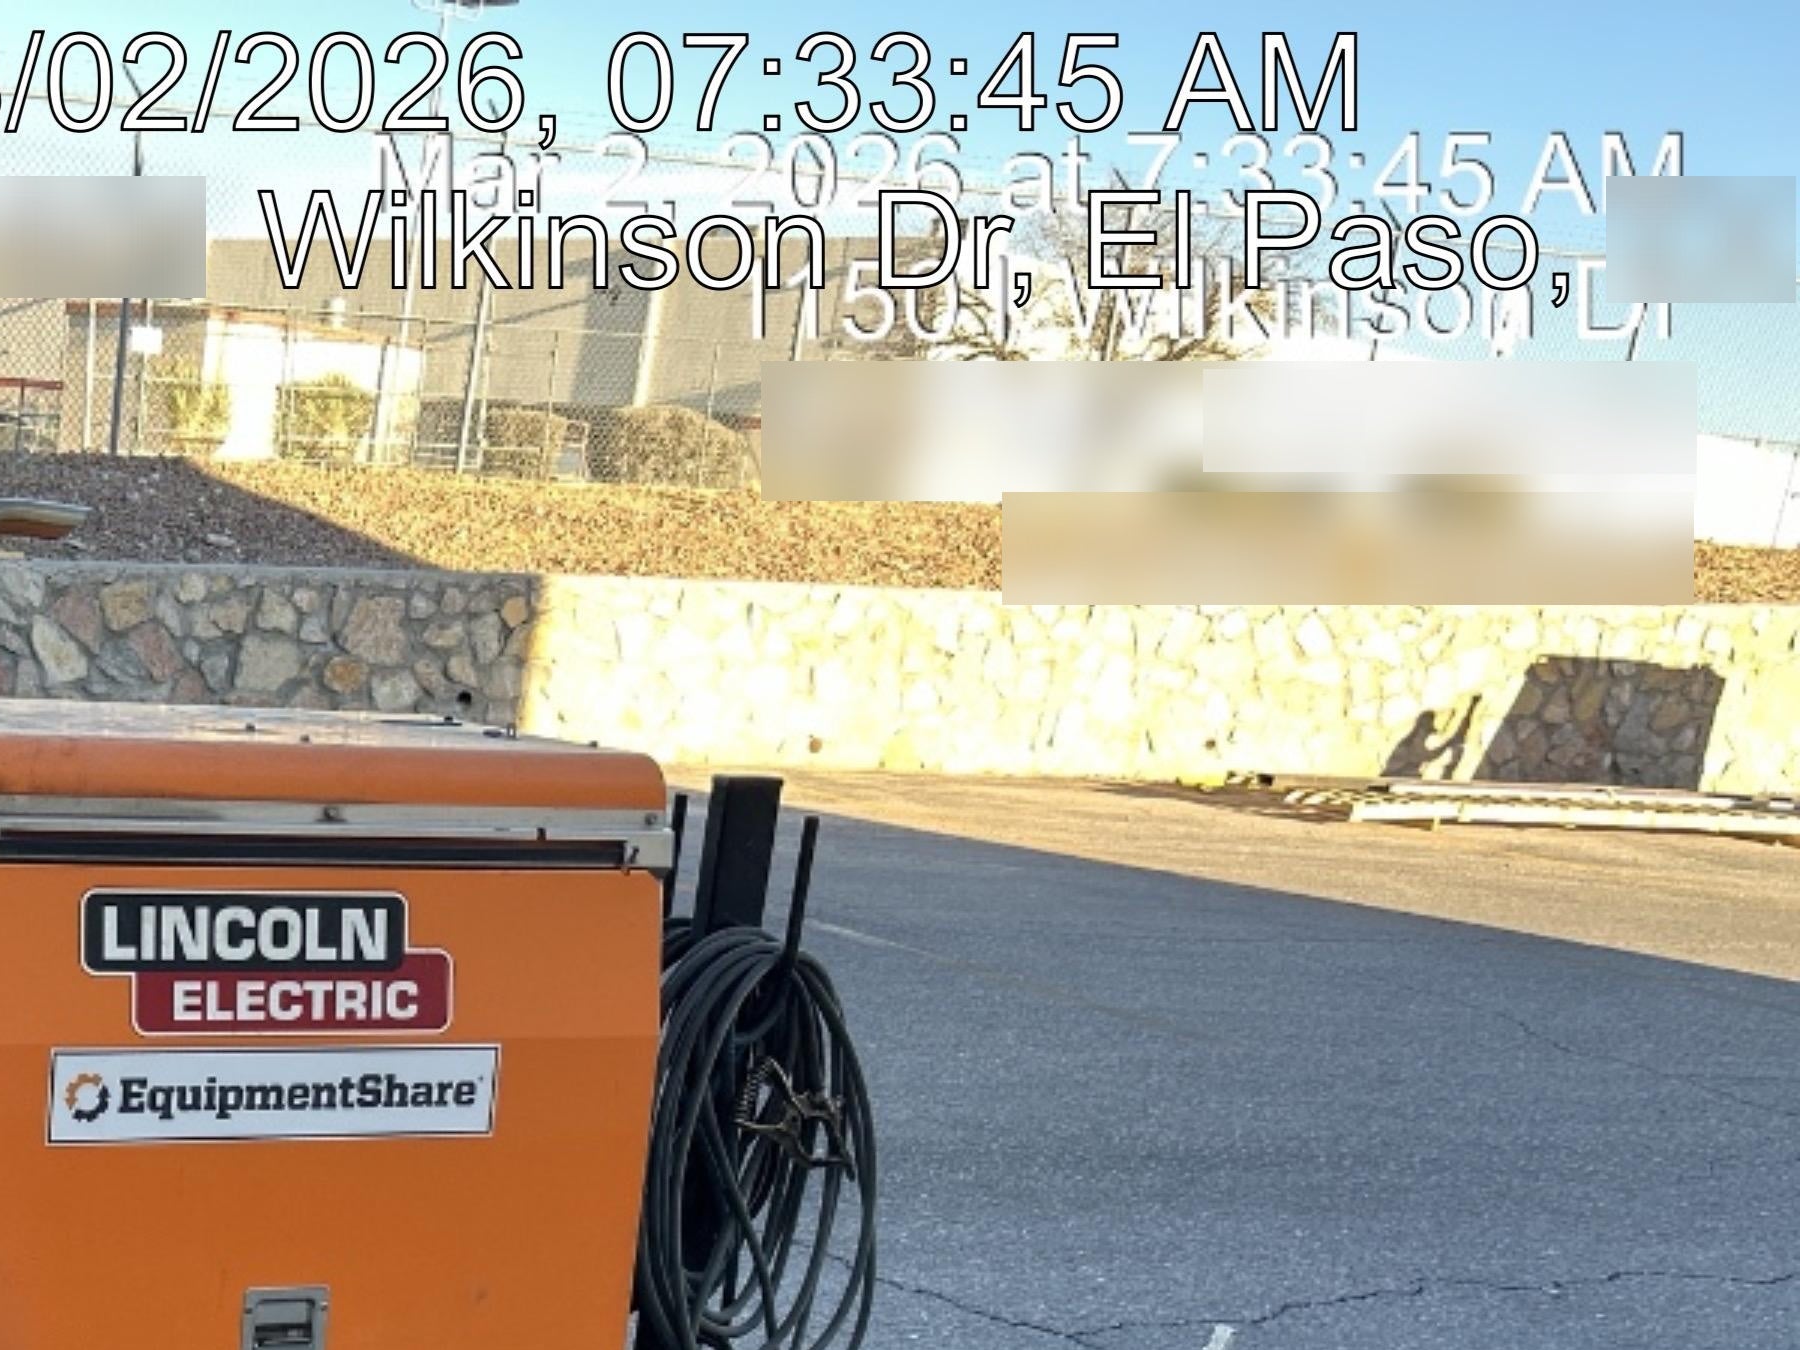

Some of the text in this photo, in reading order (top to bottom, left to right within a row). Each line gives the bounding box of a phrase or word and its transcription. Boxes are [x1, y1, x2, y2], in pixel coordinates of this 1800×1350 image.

[103, 905, 388, 961] LINCOLN
[172, 980, 419, 1021] ELECTRIC
[117, 1073, 477, 1120] EquipmentShare
